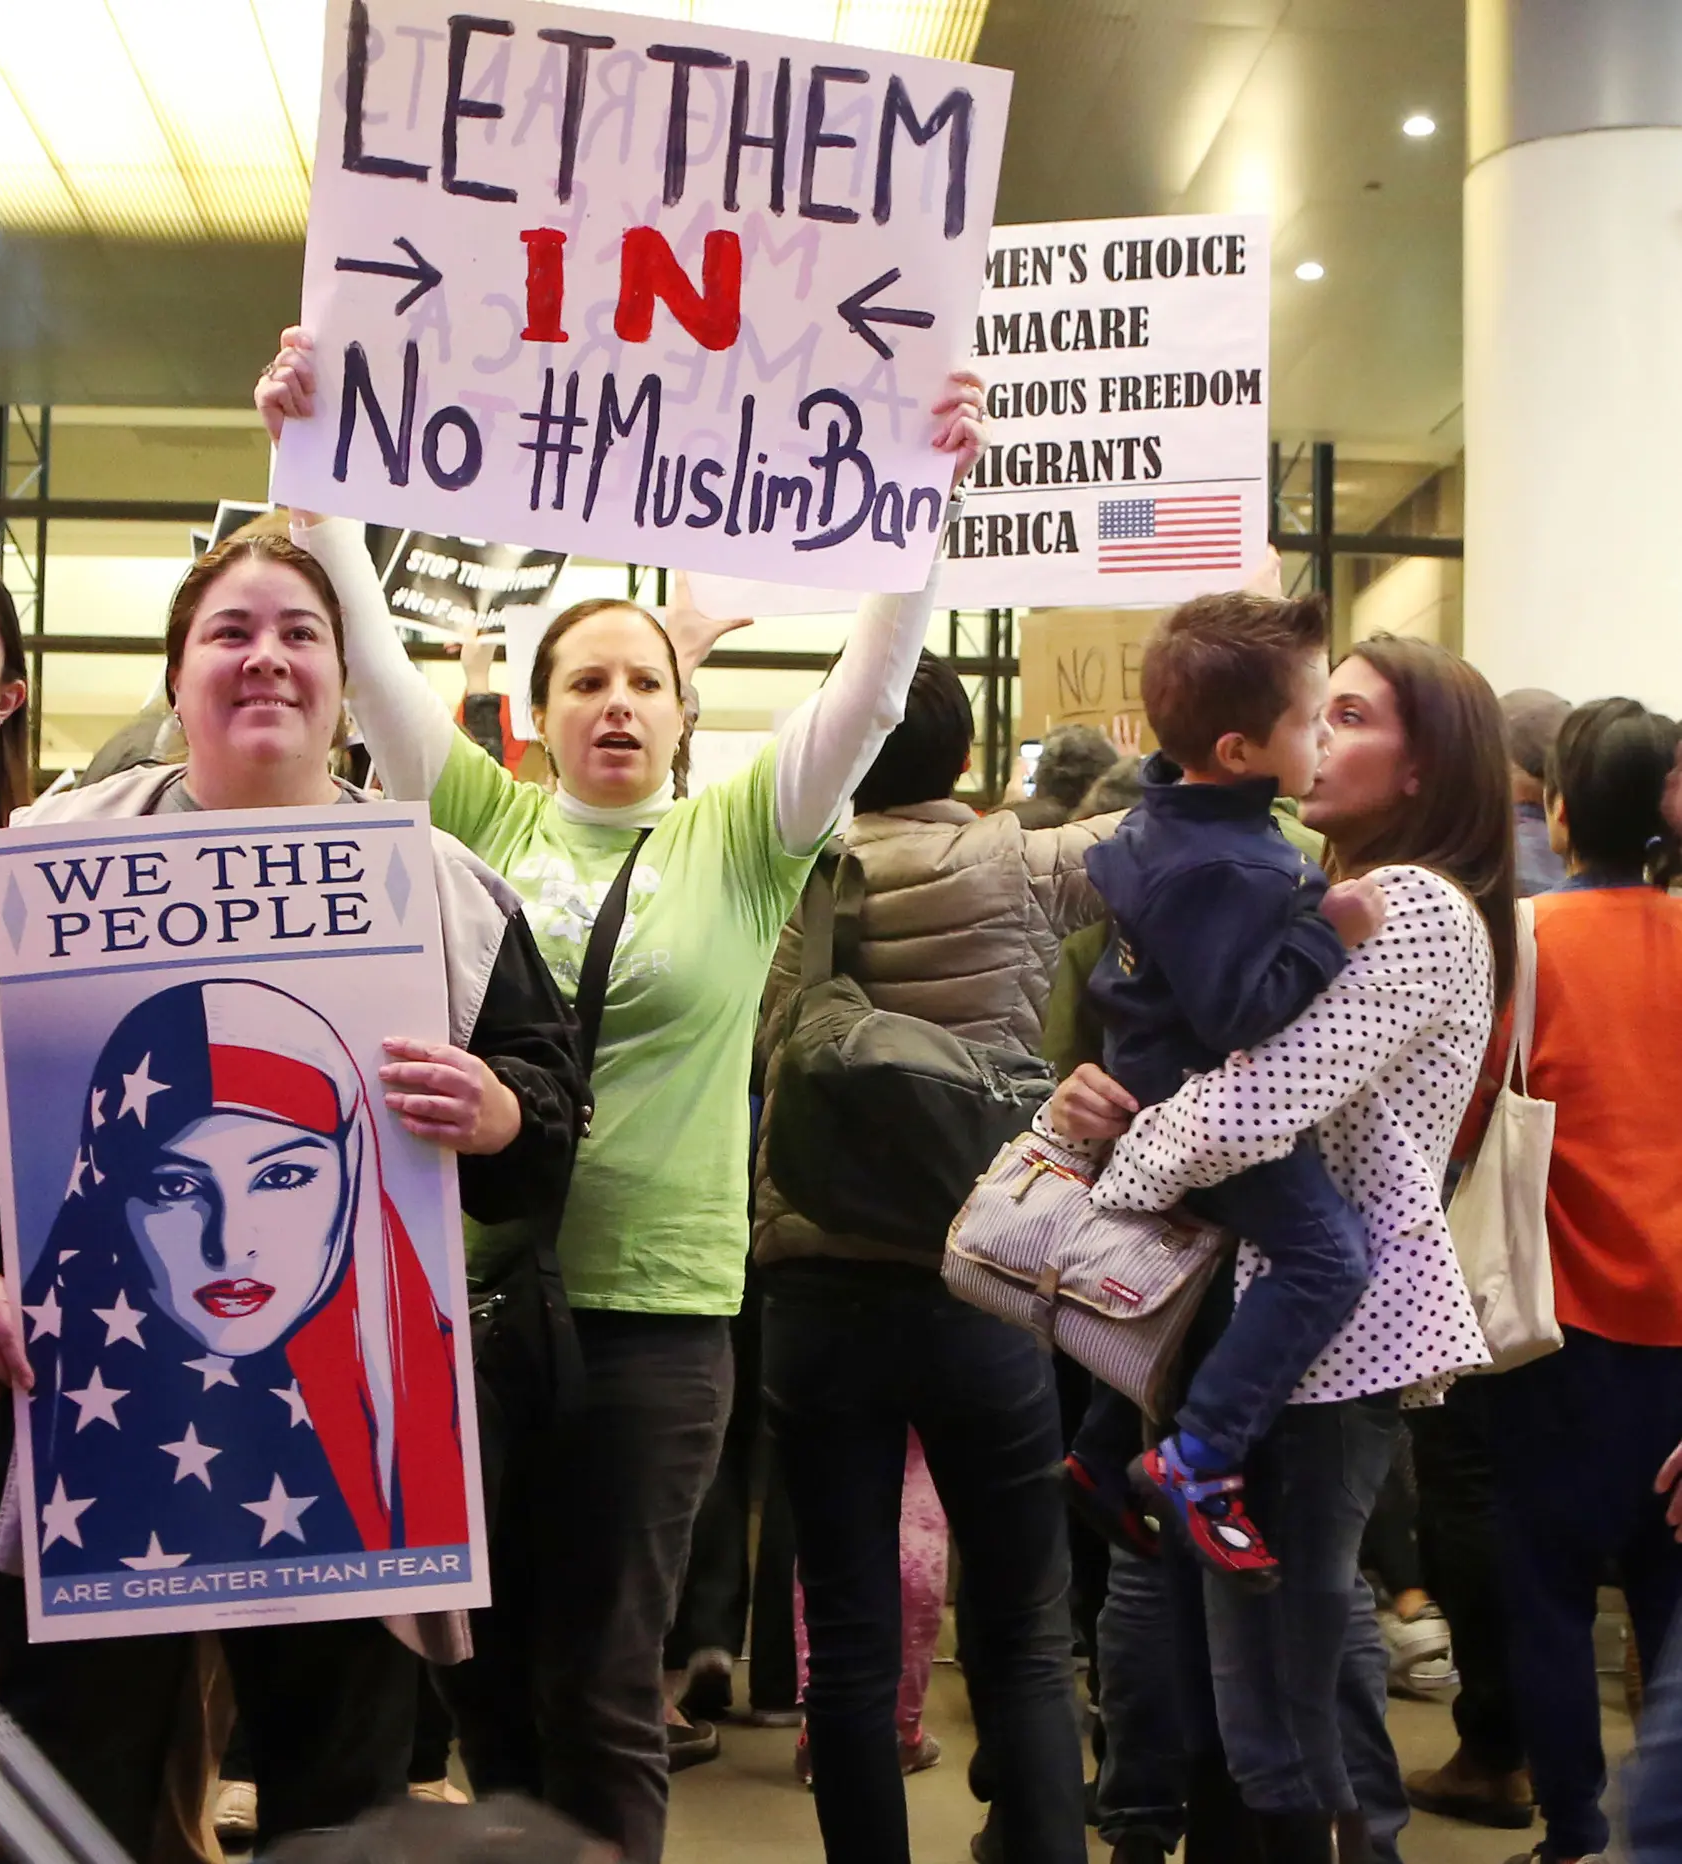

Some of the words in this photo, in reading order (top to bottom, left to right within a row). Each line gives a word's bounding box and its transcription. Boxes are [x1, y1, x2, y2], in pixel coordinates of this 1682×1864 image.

[340, 0, 617, 204] LET
[645, 43, 975, 240] THEM
[519, 226, 742, 351] IN
[982, 242, 1087, 288] MEN'S
[1103, 234, 1246, 282] CHOICE
[970, 306, 1150, 357] AMACARE
[986, 377, 1087, 419] GIOUS
[1099, 368, 1262, 414] FREEDOM
[332, 340, 483, 490] No
[518, 367, 943, 552] #MuslimBan
[942, 510, 1080, 559] MERICA
[405, 548, 460, 580] STOP
[1056, 646, 1106, 709] NO
[34, 851, 172, 904] WE
[195, 840, 365, 891] THE
[47, 892, 372, 958] PEOPLE
[52, 1582, 112, 1606] ARE
[123, 1569, 269, 1600] GREATER
[275, 1561, 368, 1587] THAN
[377, 1554, 462, 1578] FEAR
